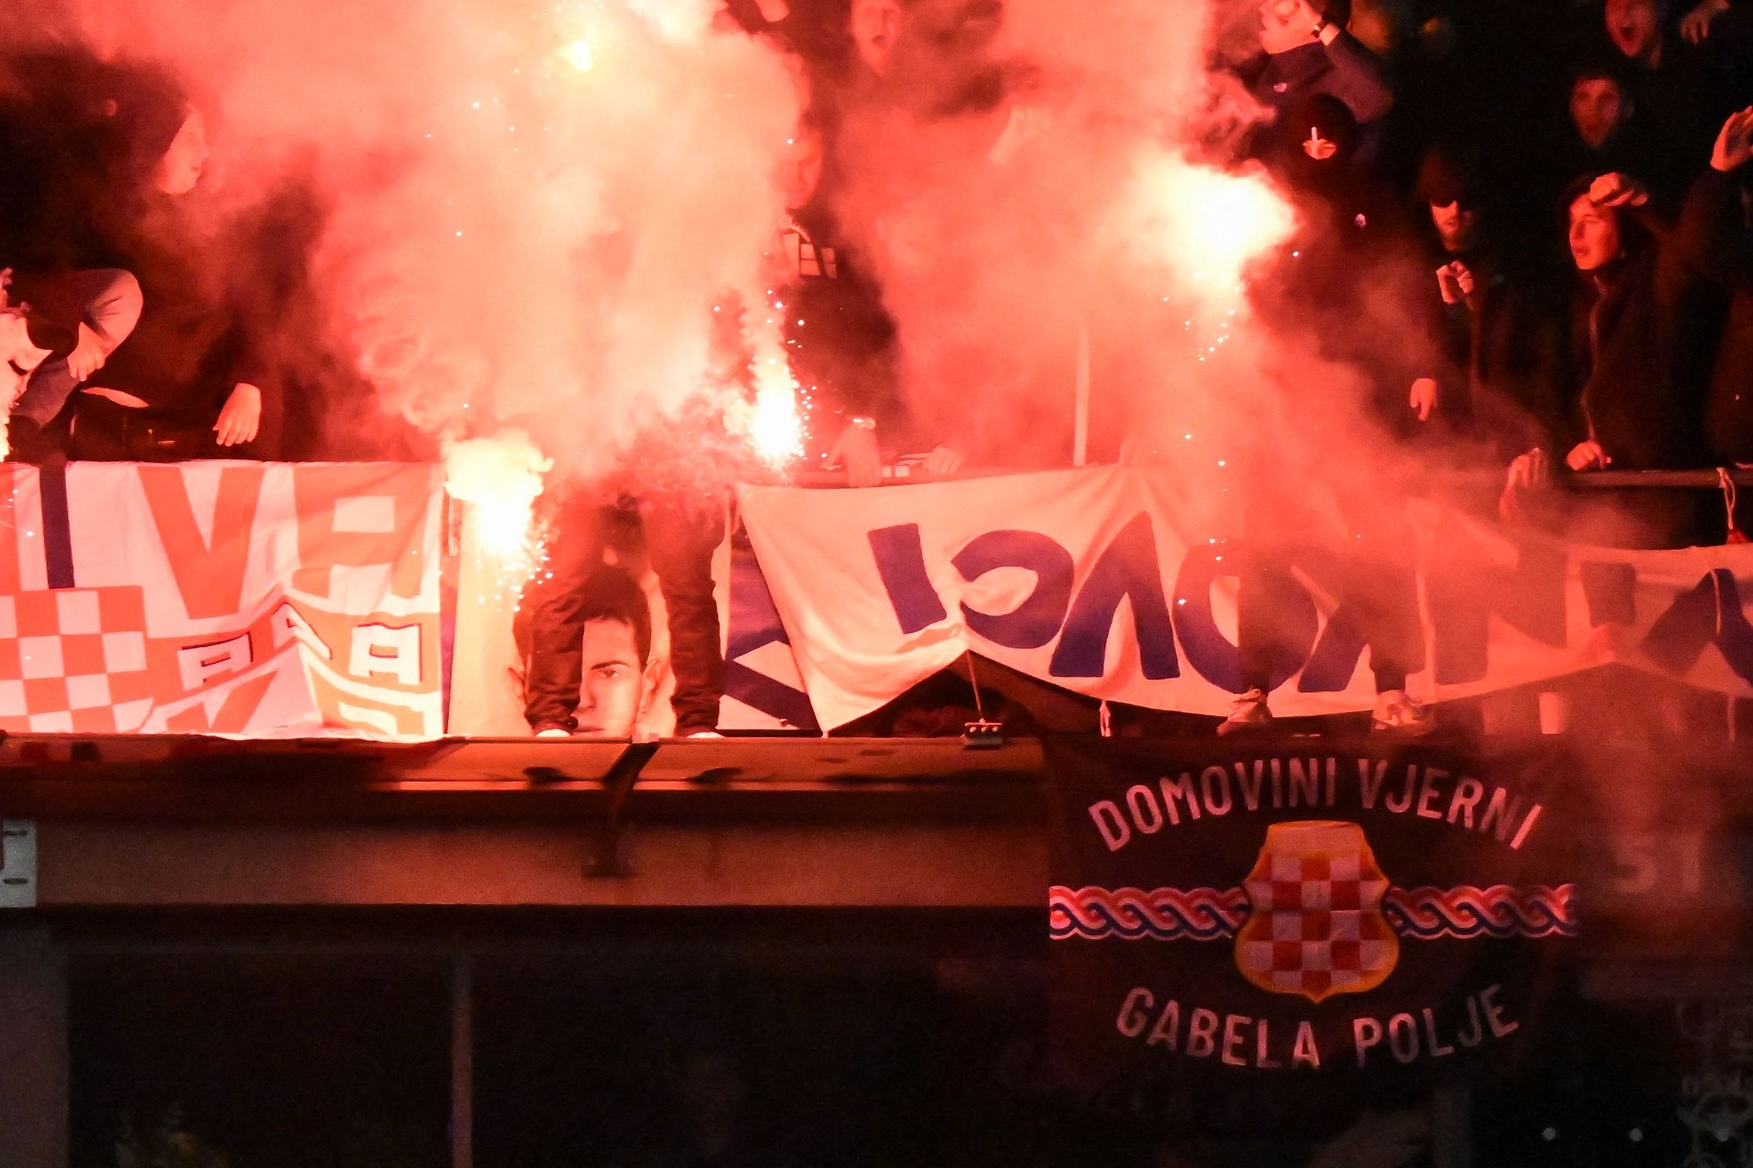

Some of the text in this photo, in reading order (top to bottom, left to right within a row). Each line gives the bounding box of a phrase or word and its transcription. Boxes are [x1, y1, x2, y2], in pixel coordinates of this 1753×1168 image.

[1088, 757, 1543, 853] DOMOVINI VJERNI
[1115, 983, 1522, 1071] GABELA POLJE
